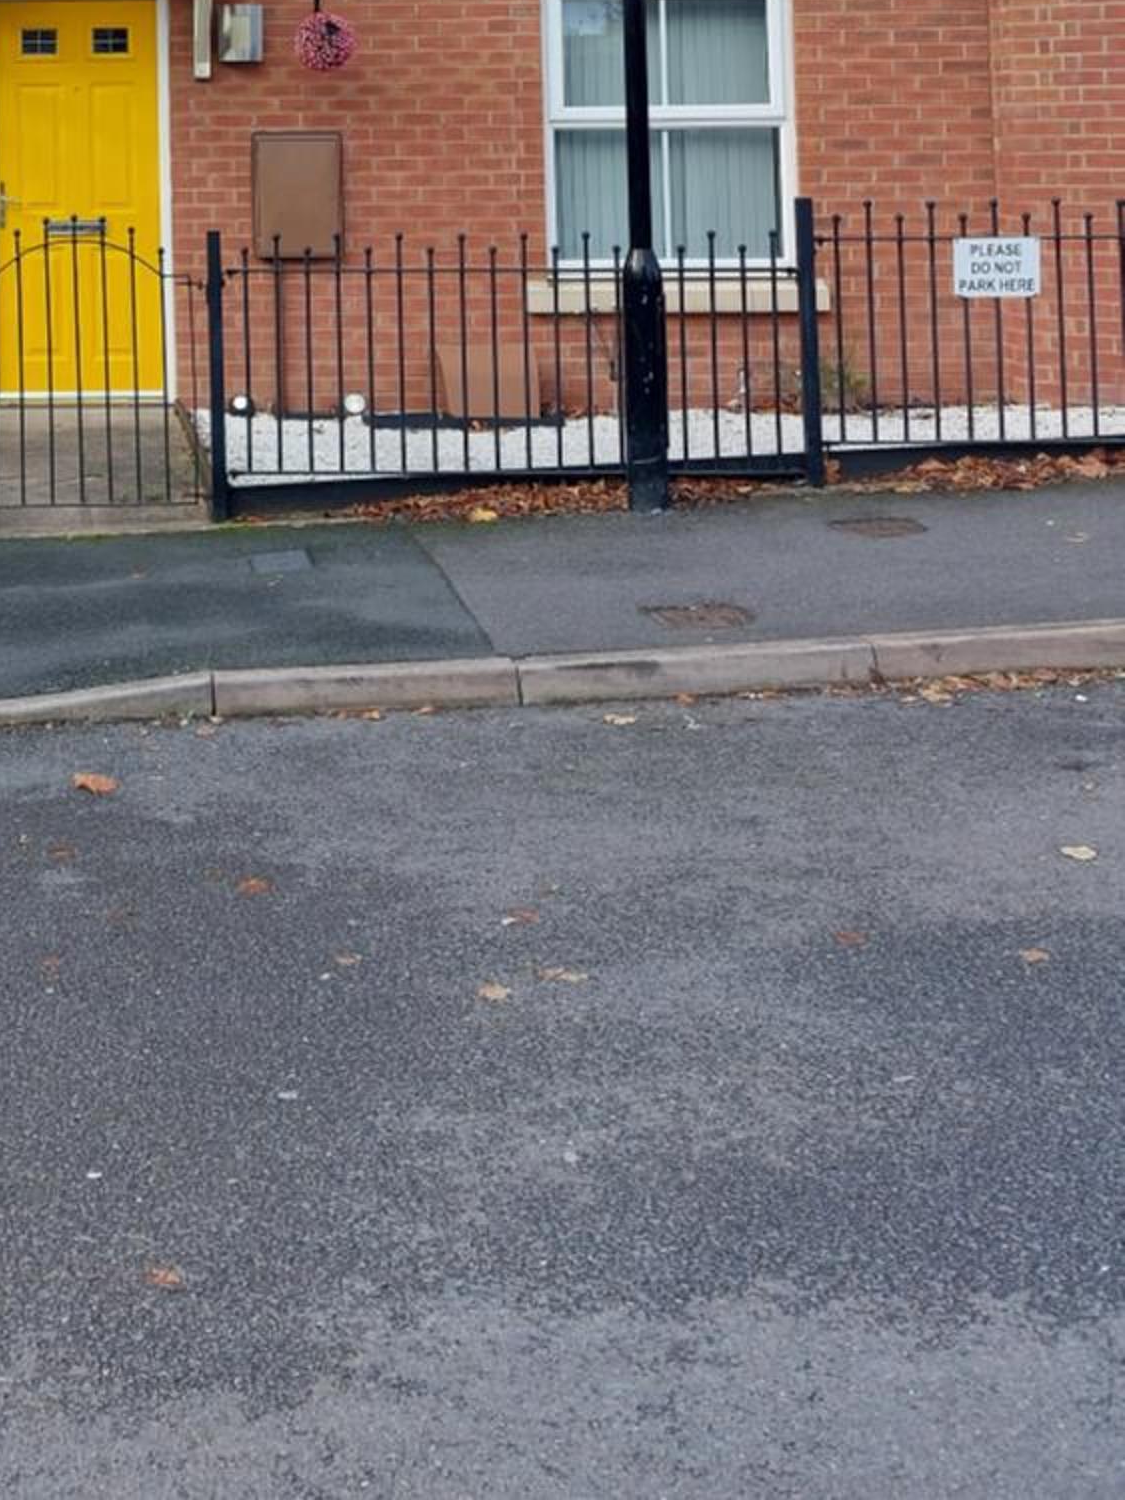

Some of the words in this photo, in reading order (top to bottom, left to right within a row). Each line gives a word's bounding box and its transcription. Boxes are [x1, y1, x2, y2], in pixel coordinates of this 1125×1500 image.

[969, 243, 1022, 257] PLEASE
[970, 261, 992, 275] DO
[994, 260, 1022, 274] NOT
[958, 279, 996, 292] PARK
[998, 278, 1035, 293] HERE
